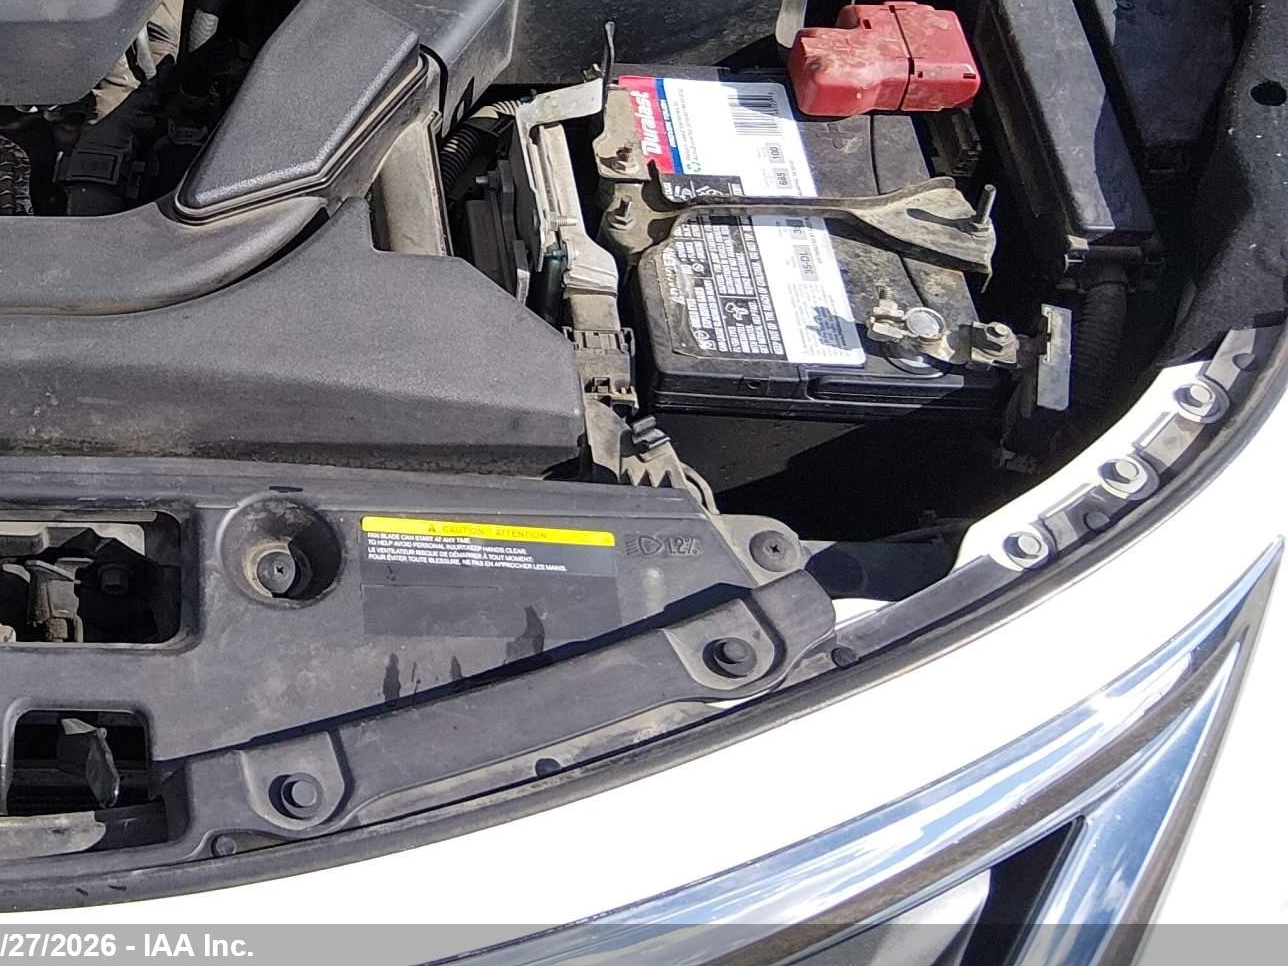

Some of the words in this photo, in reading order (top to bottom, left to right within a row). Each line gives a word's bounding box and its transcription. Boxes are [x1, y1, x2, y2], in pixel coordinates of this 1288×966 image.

[630, 90, 663, 155] Duralast
[442, 525, 484, 535] CAUTION
[495, 529, 547, 539] ATTENTION
